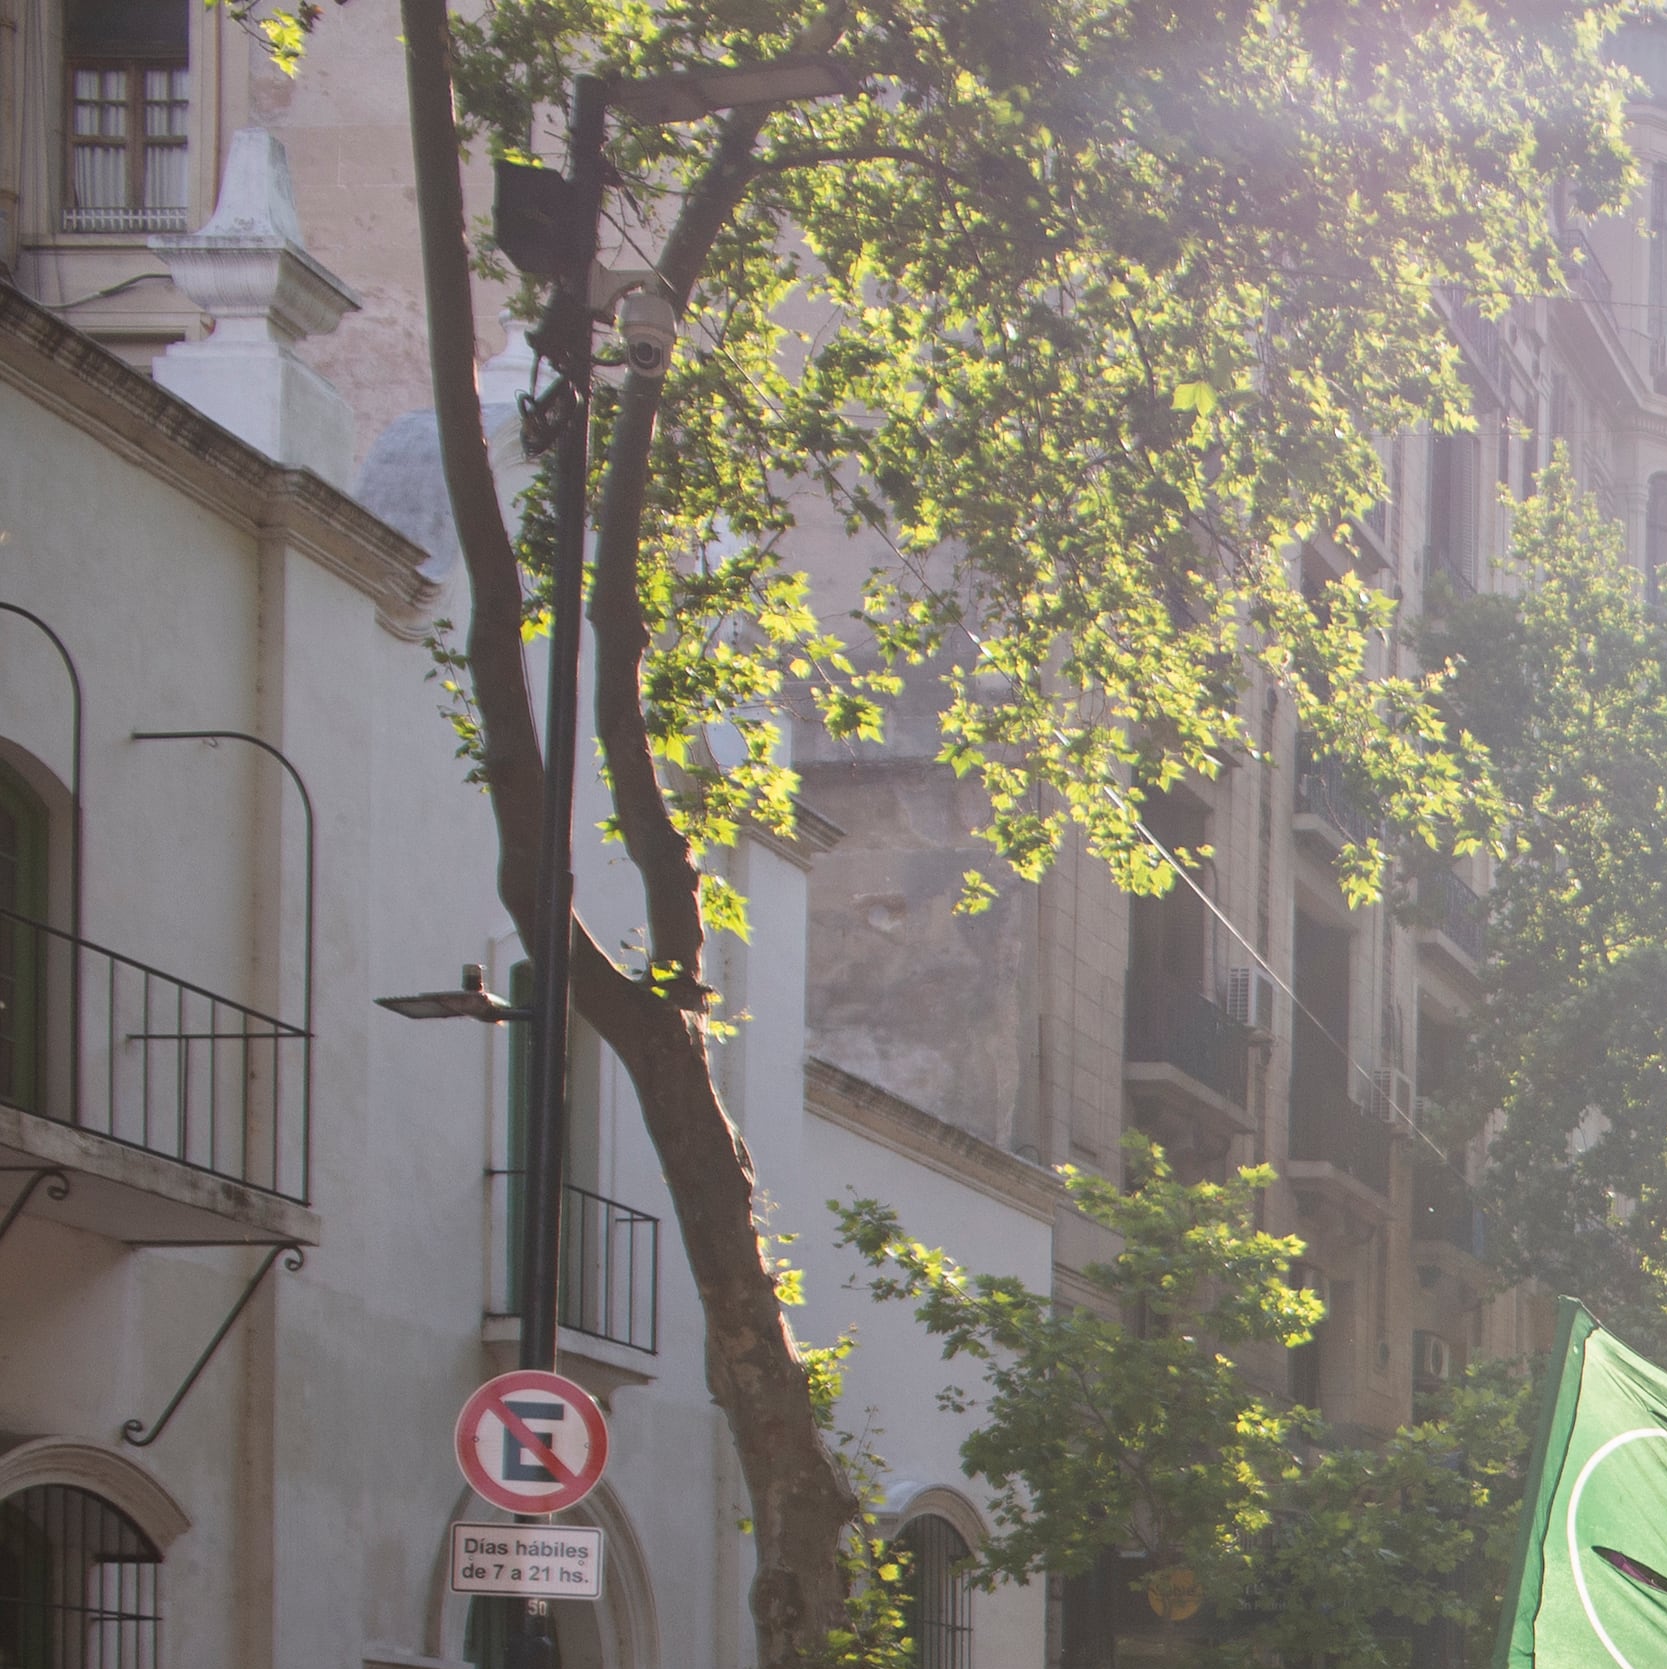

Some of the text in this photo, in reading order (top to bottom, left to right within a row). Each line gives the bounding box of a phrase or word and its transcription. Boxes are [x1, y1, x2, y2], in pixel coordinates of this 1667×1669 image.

[464, 1537, 588, 1559] Días hábiles
[462, 1563, 589, 1583] de 7 a 21 hs.
